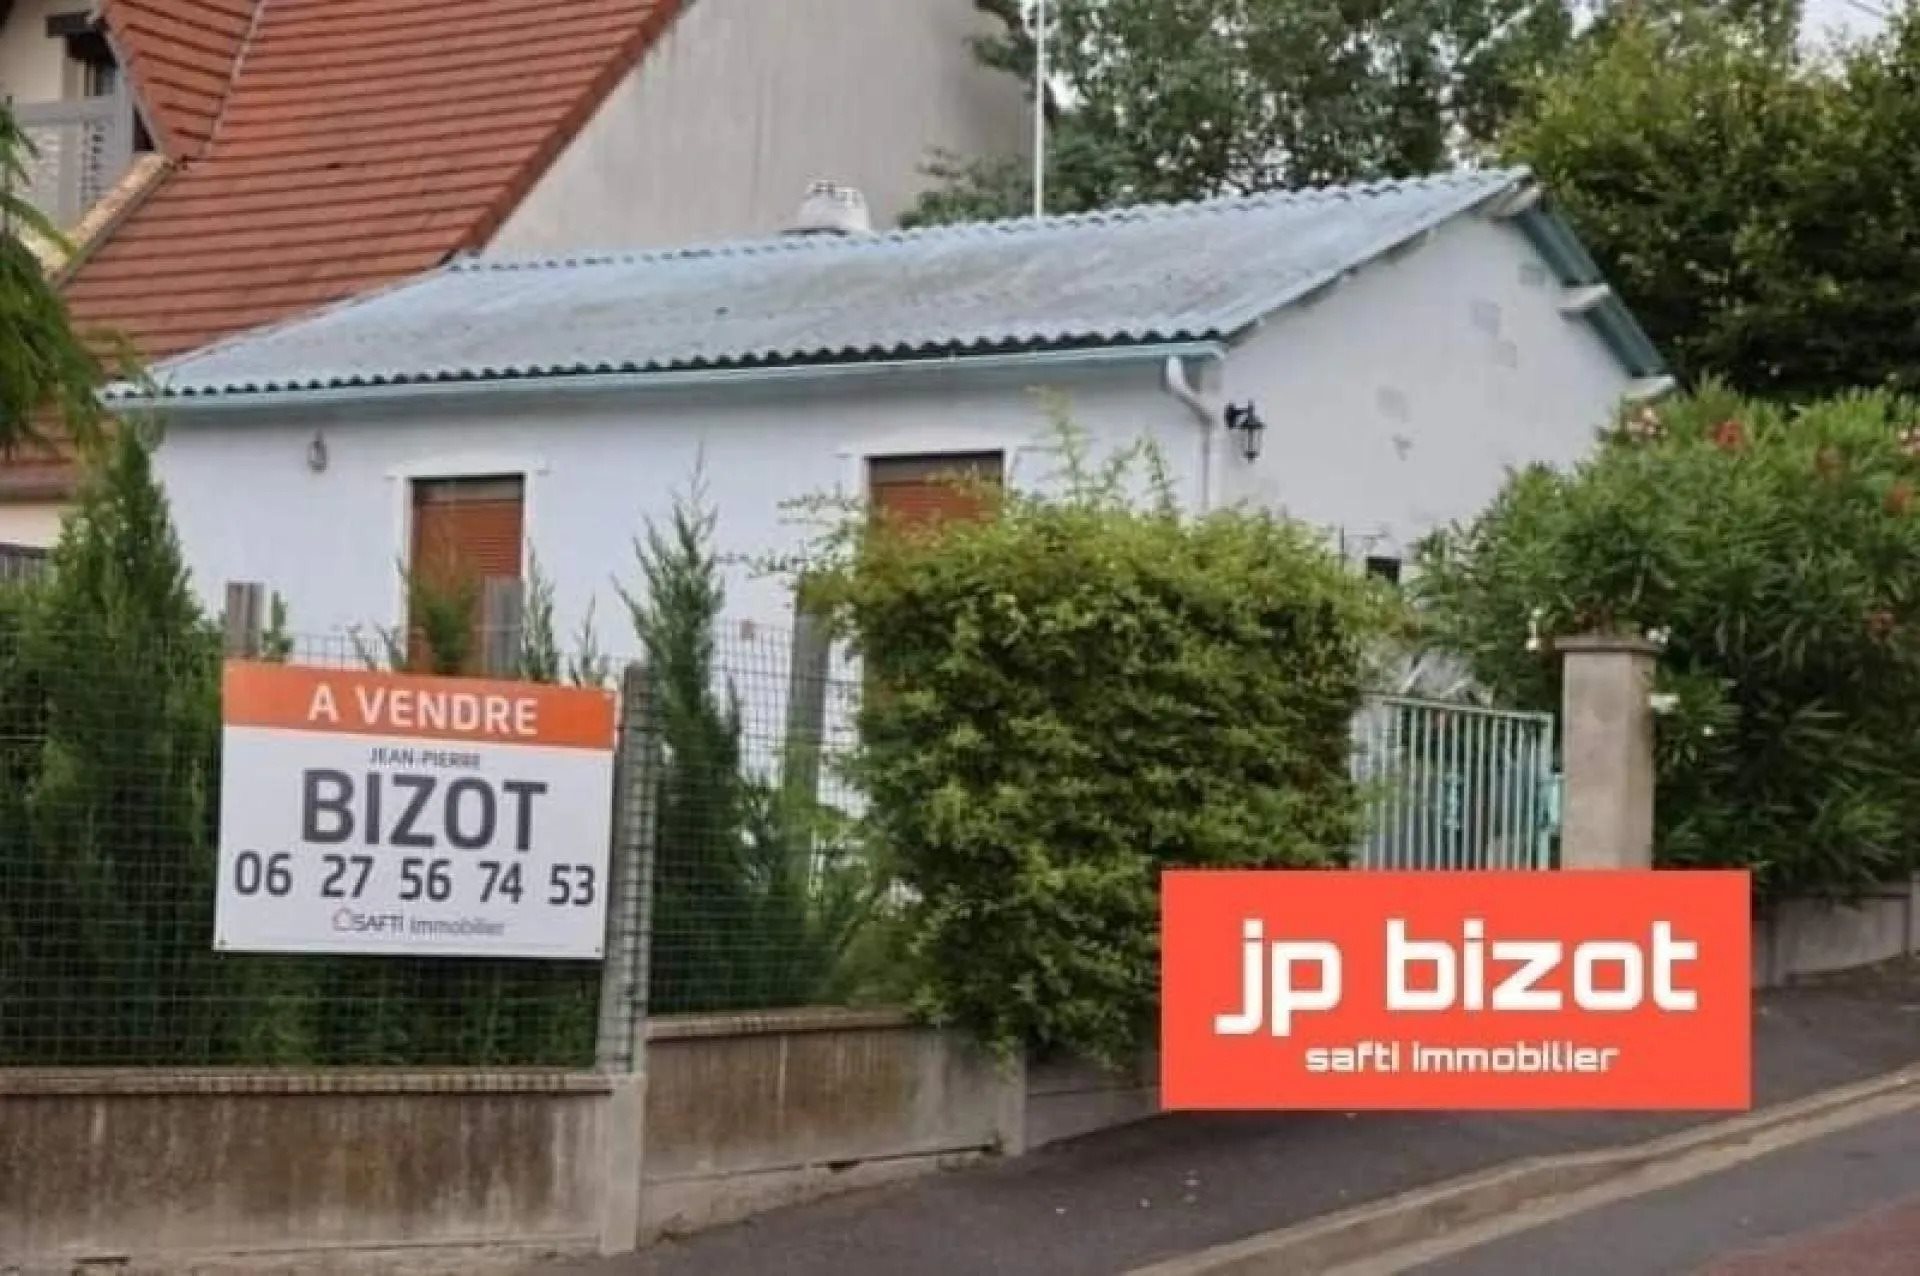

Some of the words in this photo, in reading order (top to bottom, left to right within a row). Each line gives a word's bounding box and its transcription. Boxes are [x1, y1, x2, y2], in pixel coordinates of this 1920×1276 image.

[309, 683, 338, 722] A
[356, 686, 539, 735] VENDRE
[302, 769, 548, 851] BIZOT
[234, 851, 293, 896] 06
[321, 854, 373, 898] 27
[399, 858, 450, 901] 56
[479, 862, 523, 903] 74
[549, 864, 595, 906] 53
